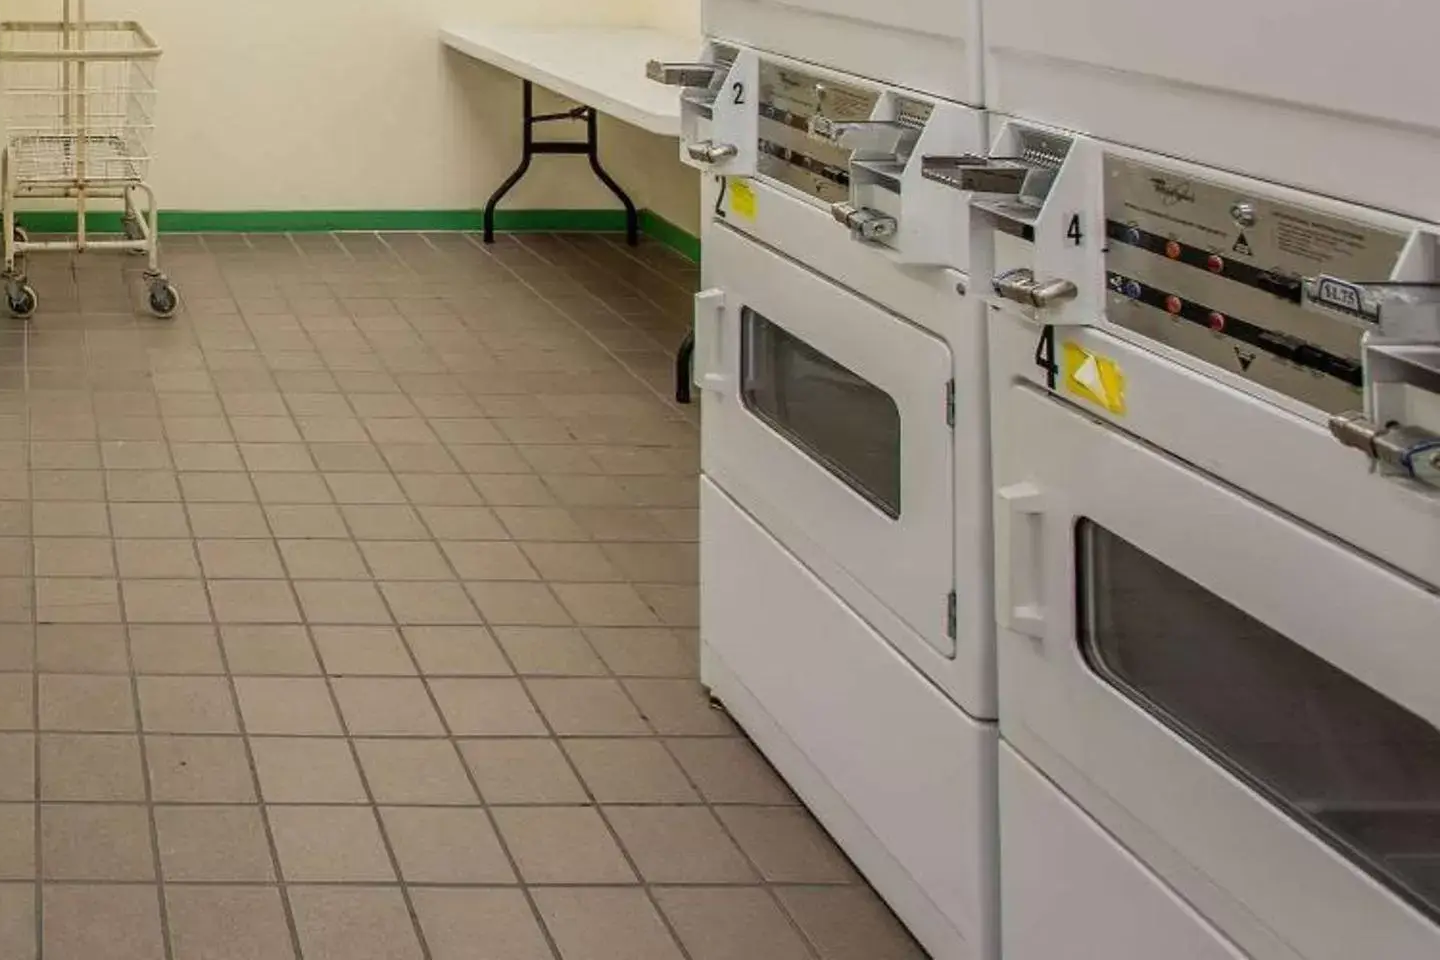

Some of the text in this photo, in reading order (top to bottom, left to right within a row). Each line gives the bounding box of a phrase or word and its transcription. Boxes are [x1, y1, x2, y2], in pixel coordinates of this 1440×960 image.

[732, 81, 745, 105] 2
[715, 175, 727, 218] 2
[1066, 213, 1085, 246] 4
[1035, 324, 1059, 391] 4
